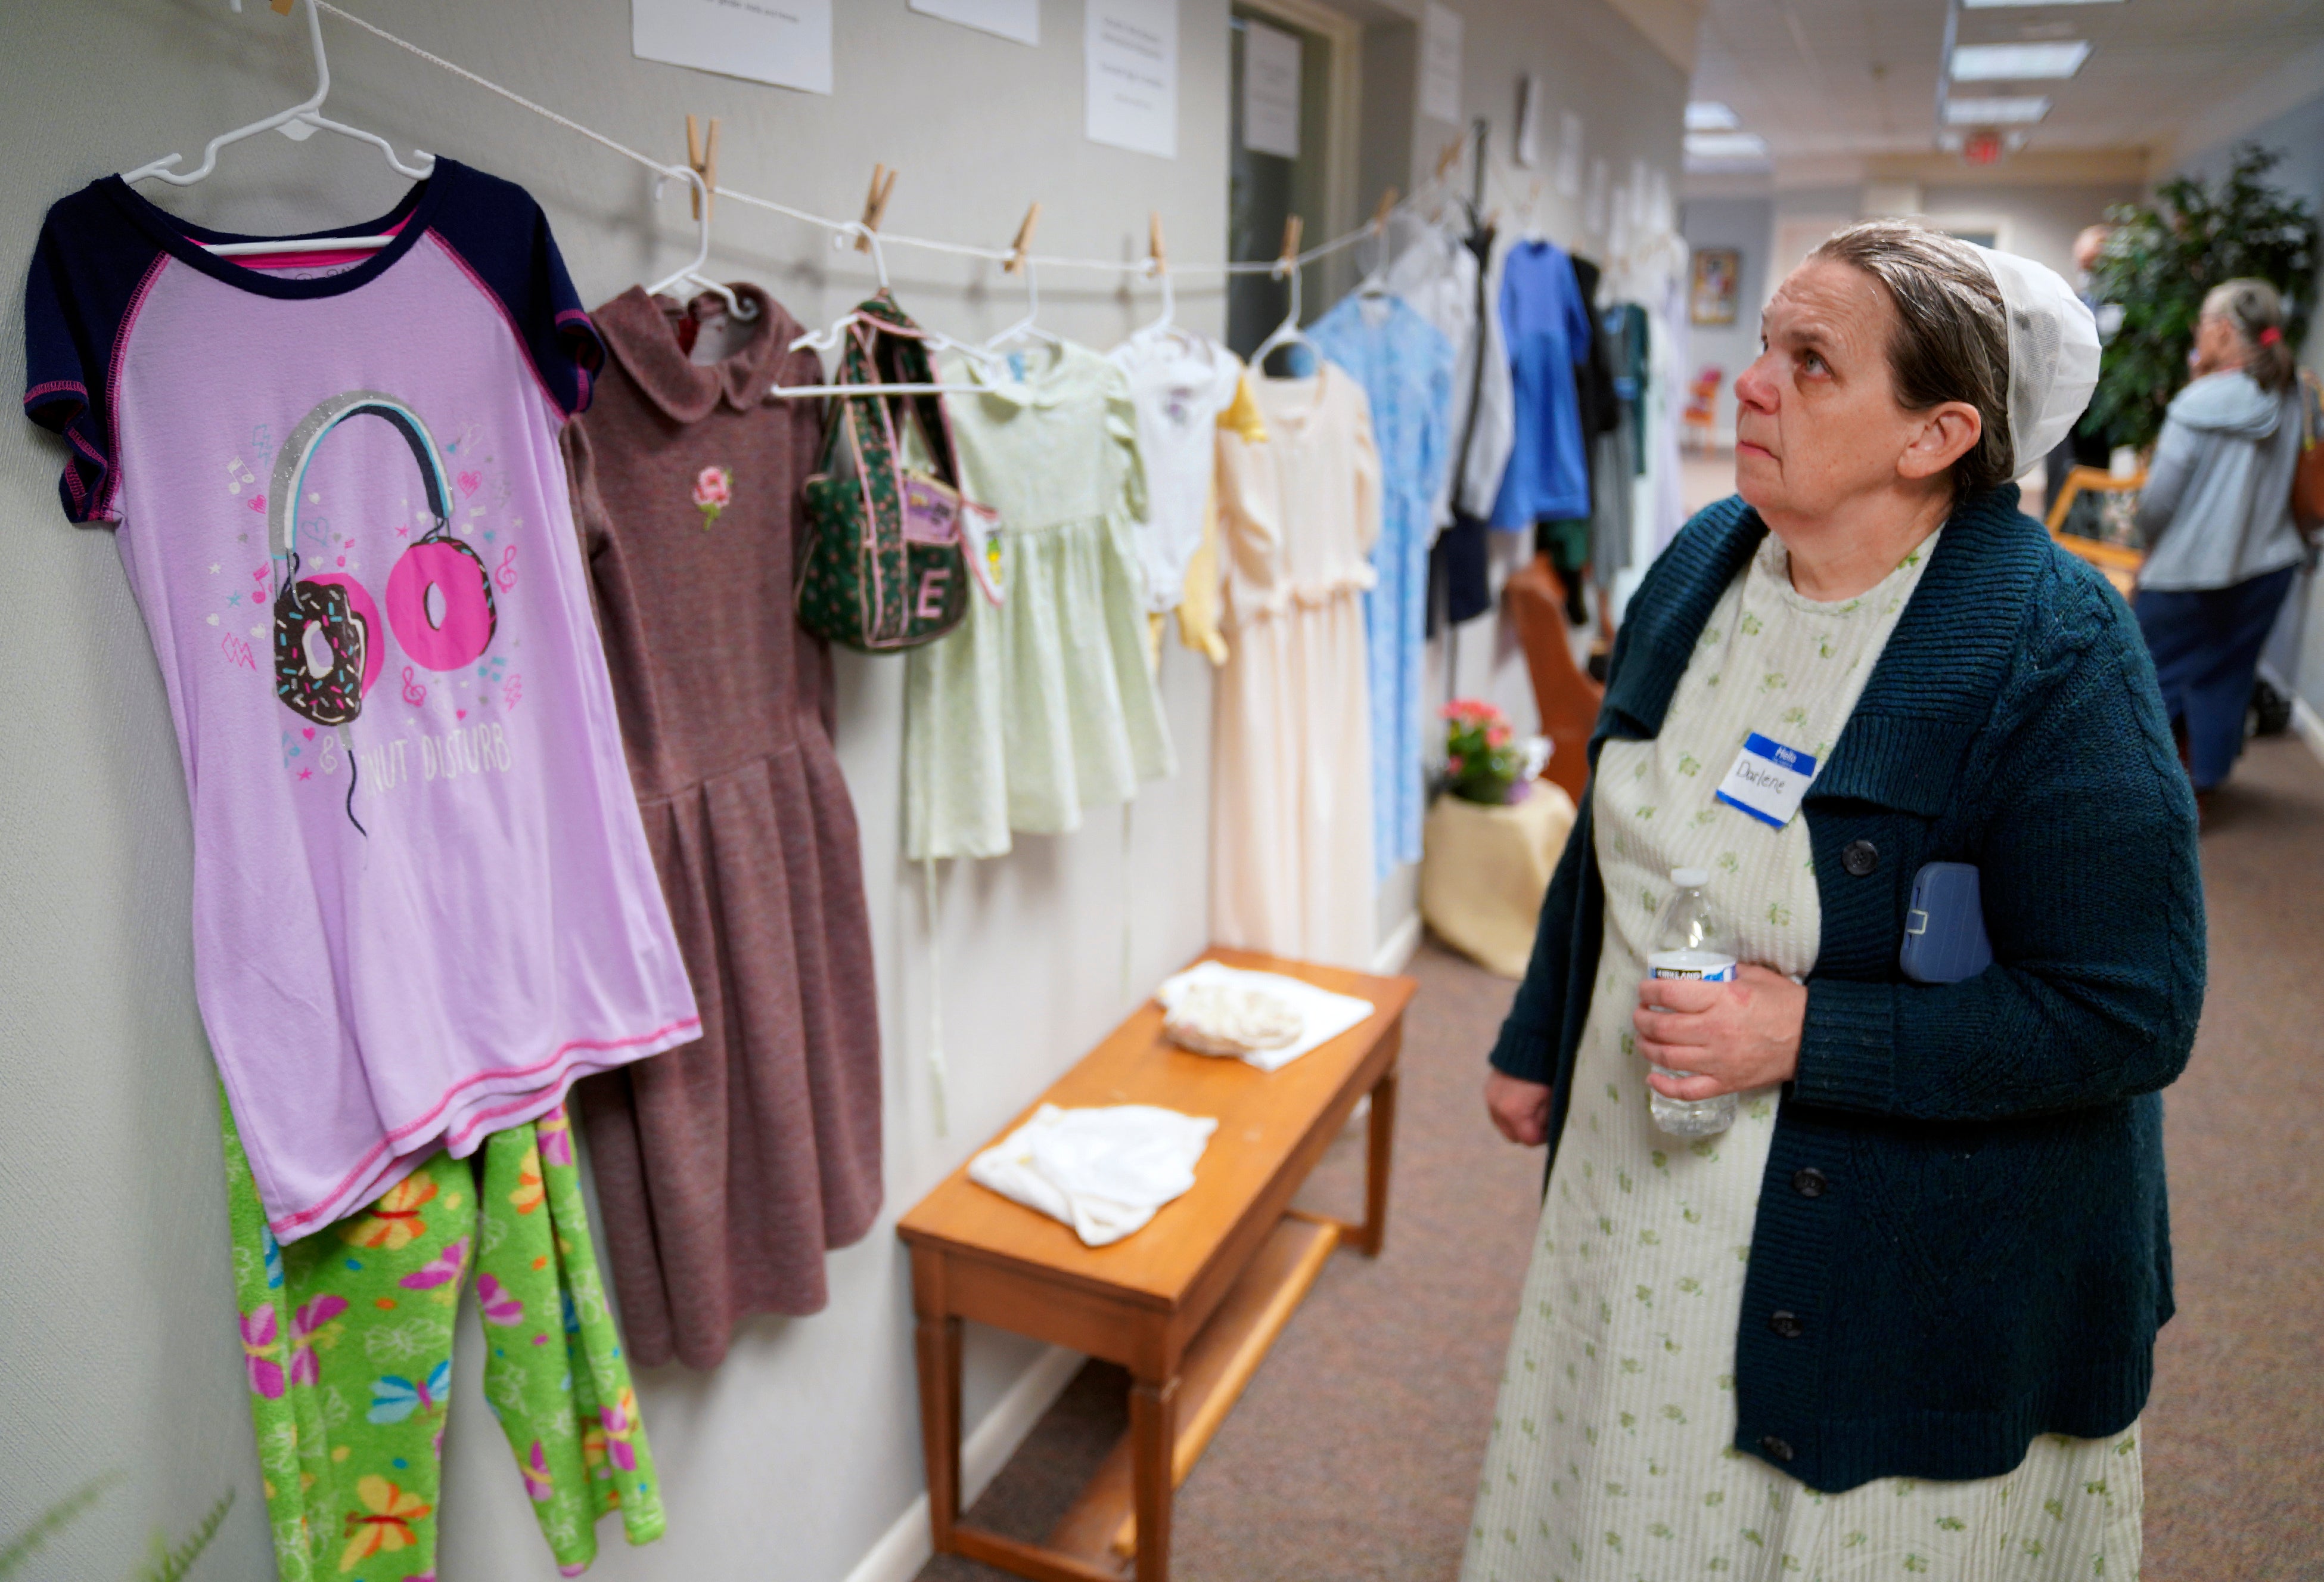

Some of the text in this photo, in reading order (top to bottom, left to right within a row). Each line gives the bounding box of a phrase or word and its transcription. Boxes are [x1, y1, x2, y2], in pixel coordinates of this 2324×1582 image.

[916, 570, 949, 618] E
[421, 722, 511, 781] DISTURB
[1736, 761, 1785, 793] Darlene
[1657, 969, 1701, 981] KIRKLAND
